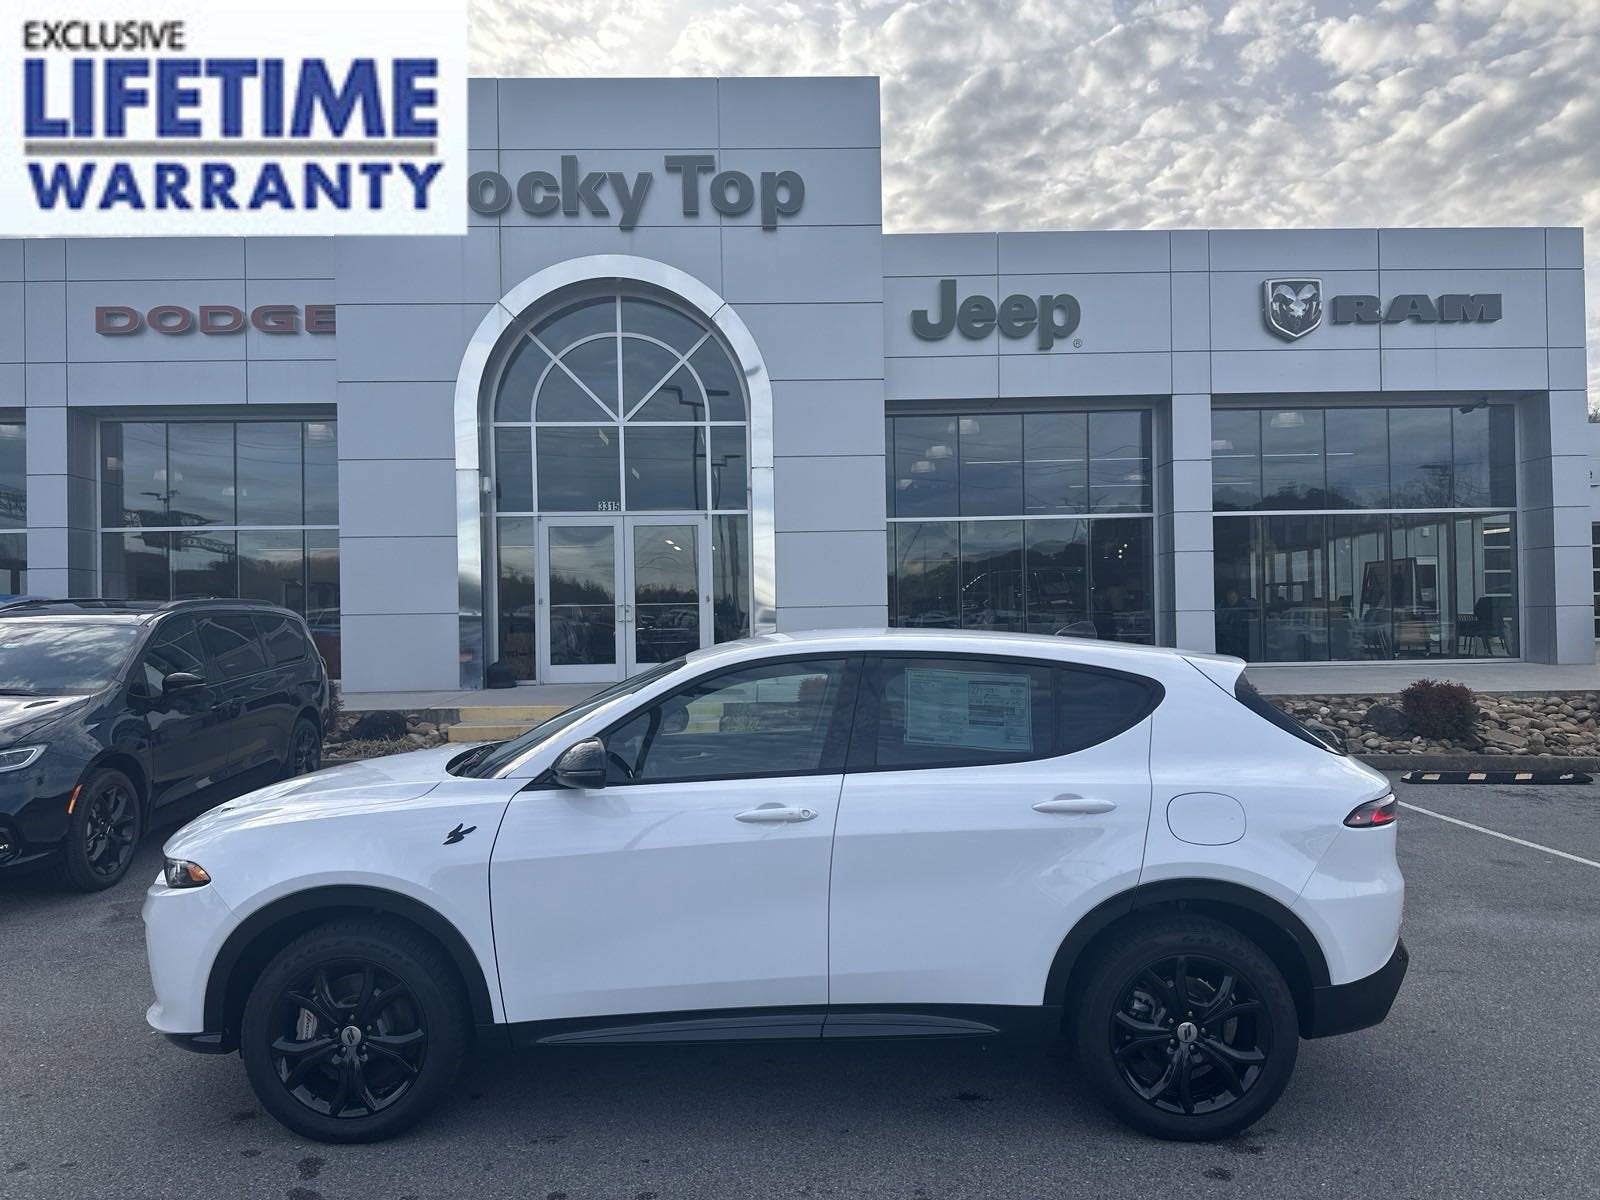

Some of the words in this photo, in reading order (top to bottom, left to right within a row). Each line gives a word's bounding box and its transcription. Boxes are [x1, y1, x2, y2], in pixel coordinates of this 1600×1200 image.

[468, 155, 653, 231] ocky
[664, 155, 805, 231] Top
[96, 304, 336, 336] DODGE
[911, 279, 1081, 351] Jeep
[1331, 294, 1502, 325] RAM
[599, 501, 619, 511] 3315
